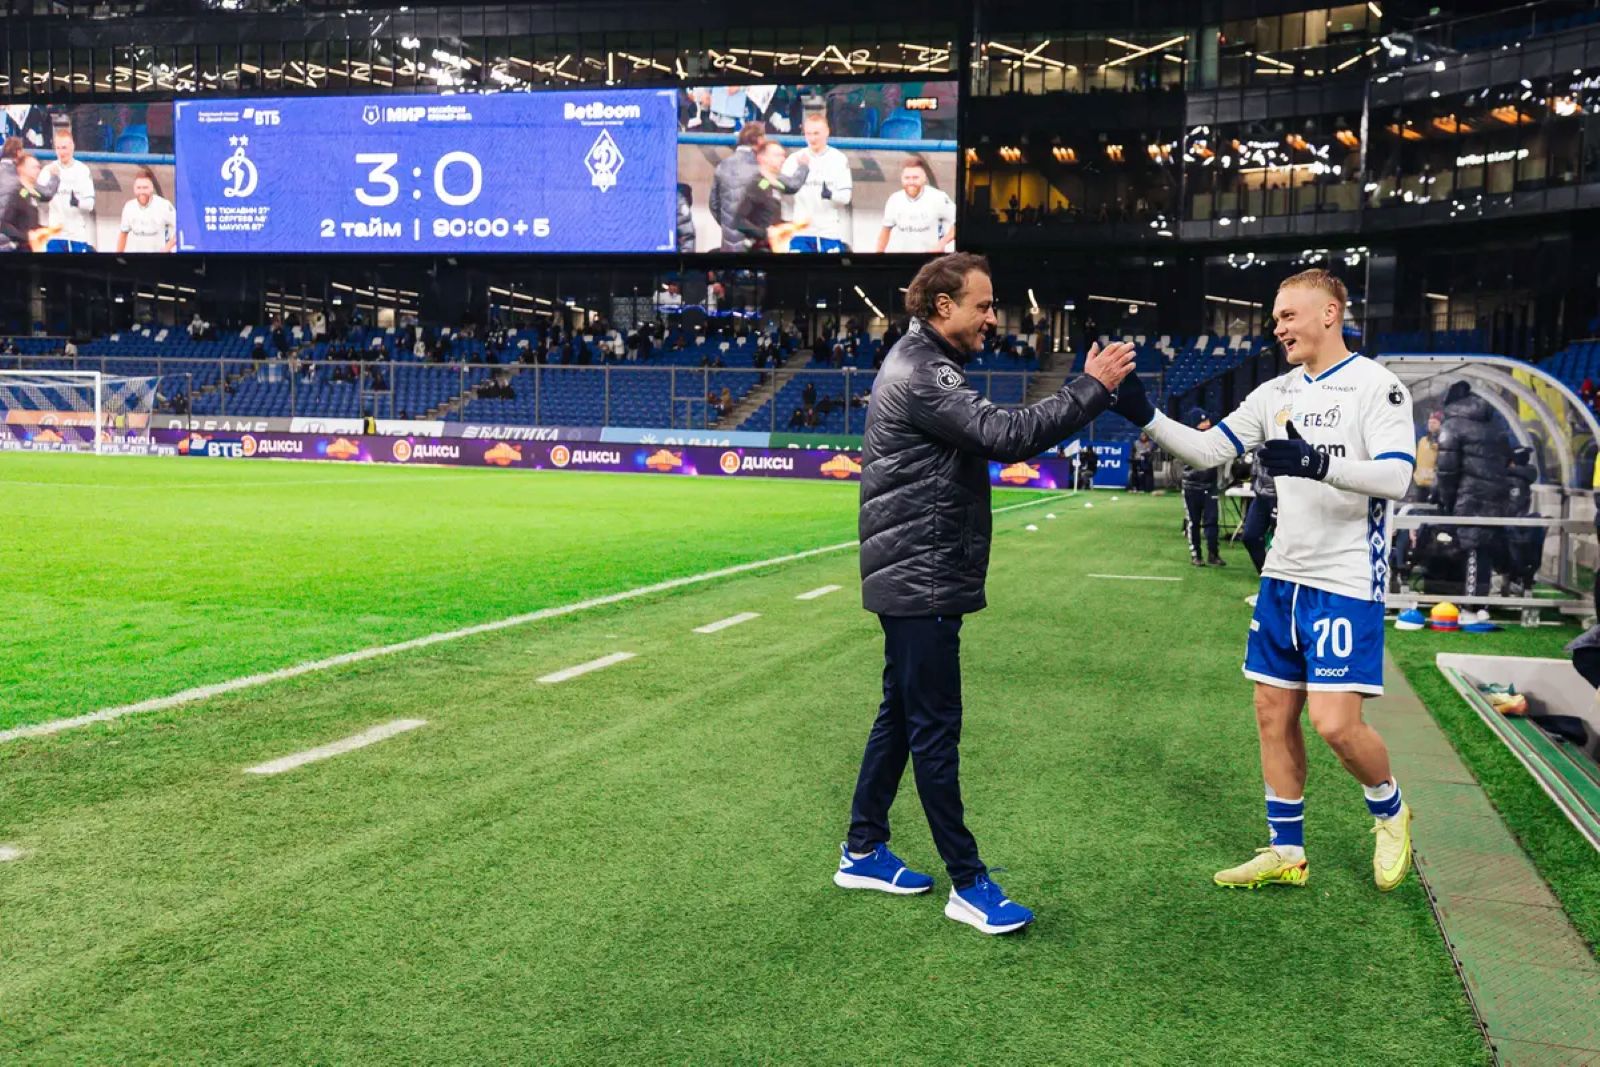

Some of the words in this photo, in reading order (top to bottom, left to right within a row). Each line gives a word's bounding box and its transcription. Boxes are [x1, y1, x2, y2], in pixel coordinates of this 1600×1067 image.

[255, 109, 281, 126] ВТБ
[386, 107, 426, 122] МИР
[564, 102, 640, 120] BetBoom
[320, 218, 335, 237] 2
[341, 216, 402, 237] тайм
[479, 425, 560, 441] БАЛТИКА
[208, 442, 243, 457] ВТБ
[1313, 617, 1353, 658] 70
[1315, 667, 1345, 677] BOSCO
